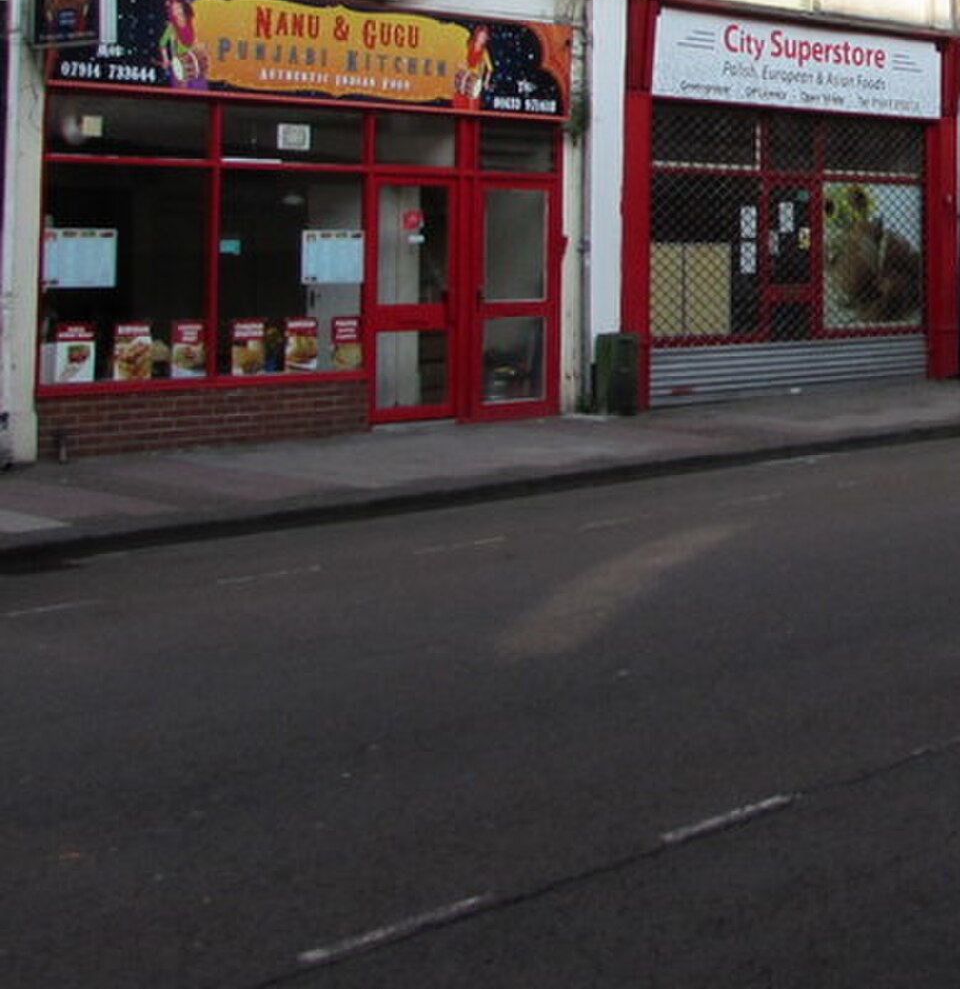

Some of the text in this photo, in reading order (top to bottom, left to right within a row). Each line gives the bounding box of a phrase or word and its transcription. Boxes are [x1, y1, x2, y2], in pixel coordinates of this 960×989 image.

[255, 6, 320, 40] NANU
[333, 15, 350, 41] &
[216, 37, 448, 77] PUNJABI KITCHEN
[723, 24, 886, 69] City Superstore
[761, 64, 814, 86] European
[816, 72, 824, 86] &
[857, 74, 887, 91] Foods
